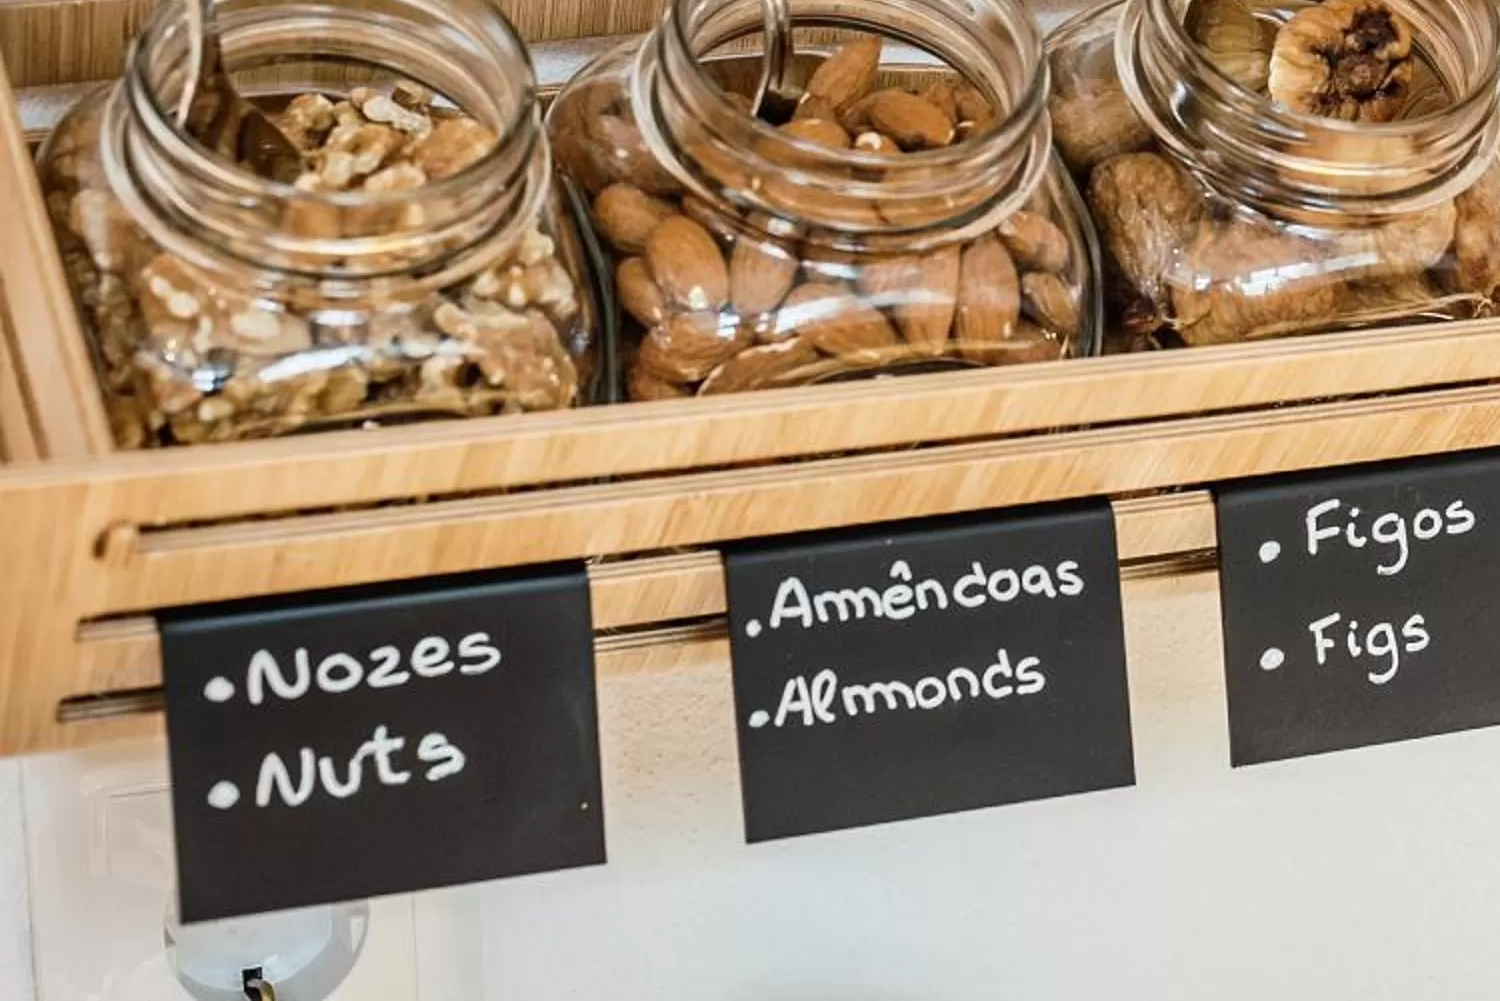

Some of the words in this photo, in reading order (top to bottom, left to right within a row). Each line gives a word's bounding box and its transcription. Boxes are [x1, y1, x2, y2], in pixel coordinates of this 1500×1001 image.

[1305, 498, 1476, 575] Figos
[769, 560, 1085, 629] Amêndoas
[246, 631, 502, 705] Nozes
[1308, 612, 1431, 685] Figs
[773, 648, 1046, 728] Almonds
[255, 724, 466, 808] Nuts
